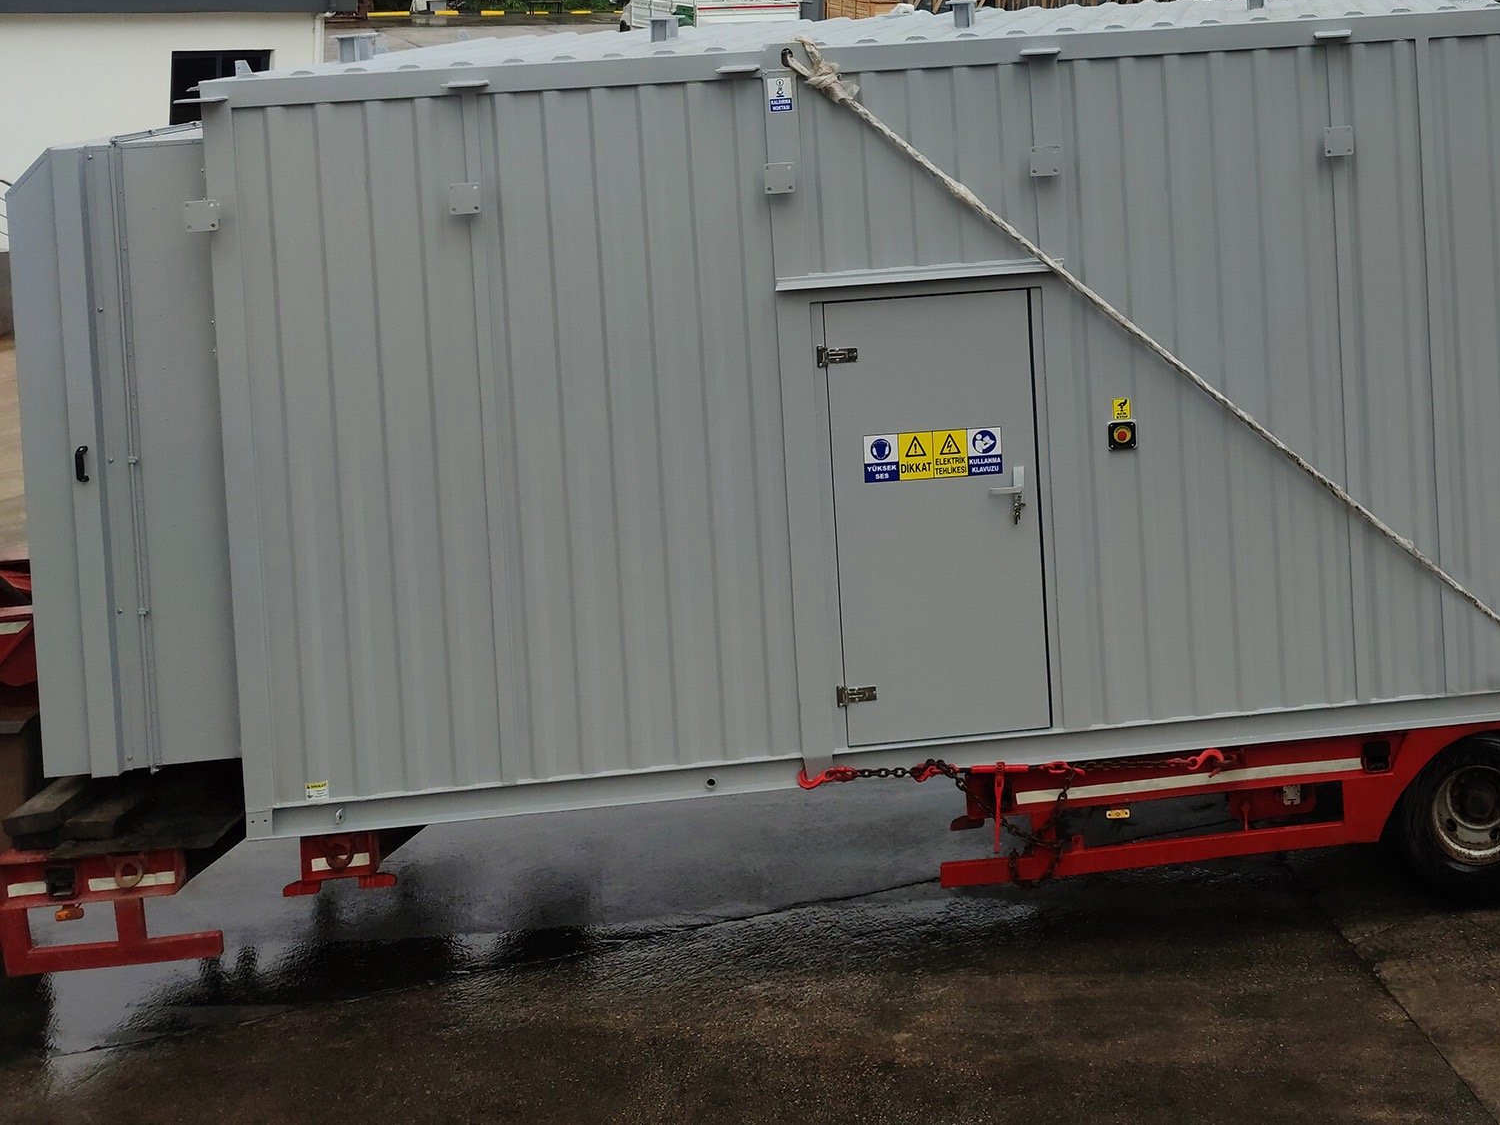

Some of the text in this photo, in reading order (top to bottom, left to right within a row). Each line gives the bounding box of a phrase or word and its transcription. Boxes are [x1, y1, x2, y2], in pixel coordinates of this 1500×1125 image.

[969, 456, 1001, 465] KULLANMA
[867, 465, 897, 473] YÜKSEK
[900, 461, 932, 474] DİKKAT
[971, 465, 999, 473] KLAVUZU
[875, 472, 890, 480] SES
